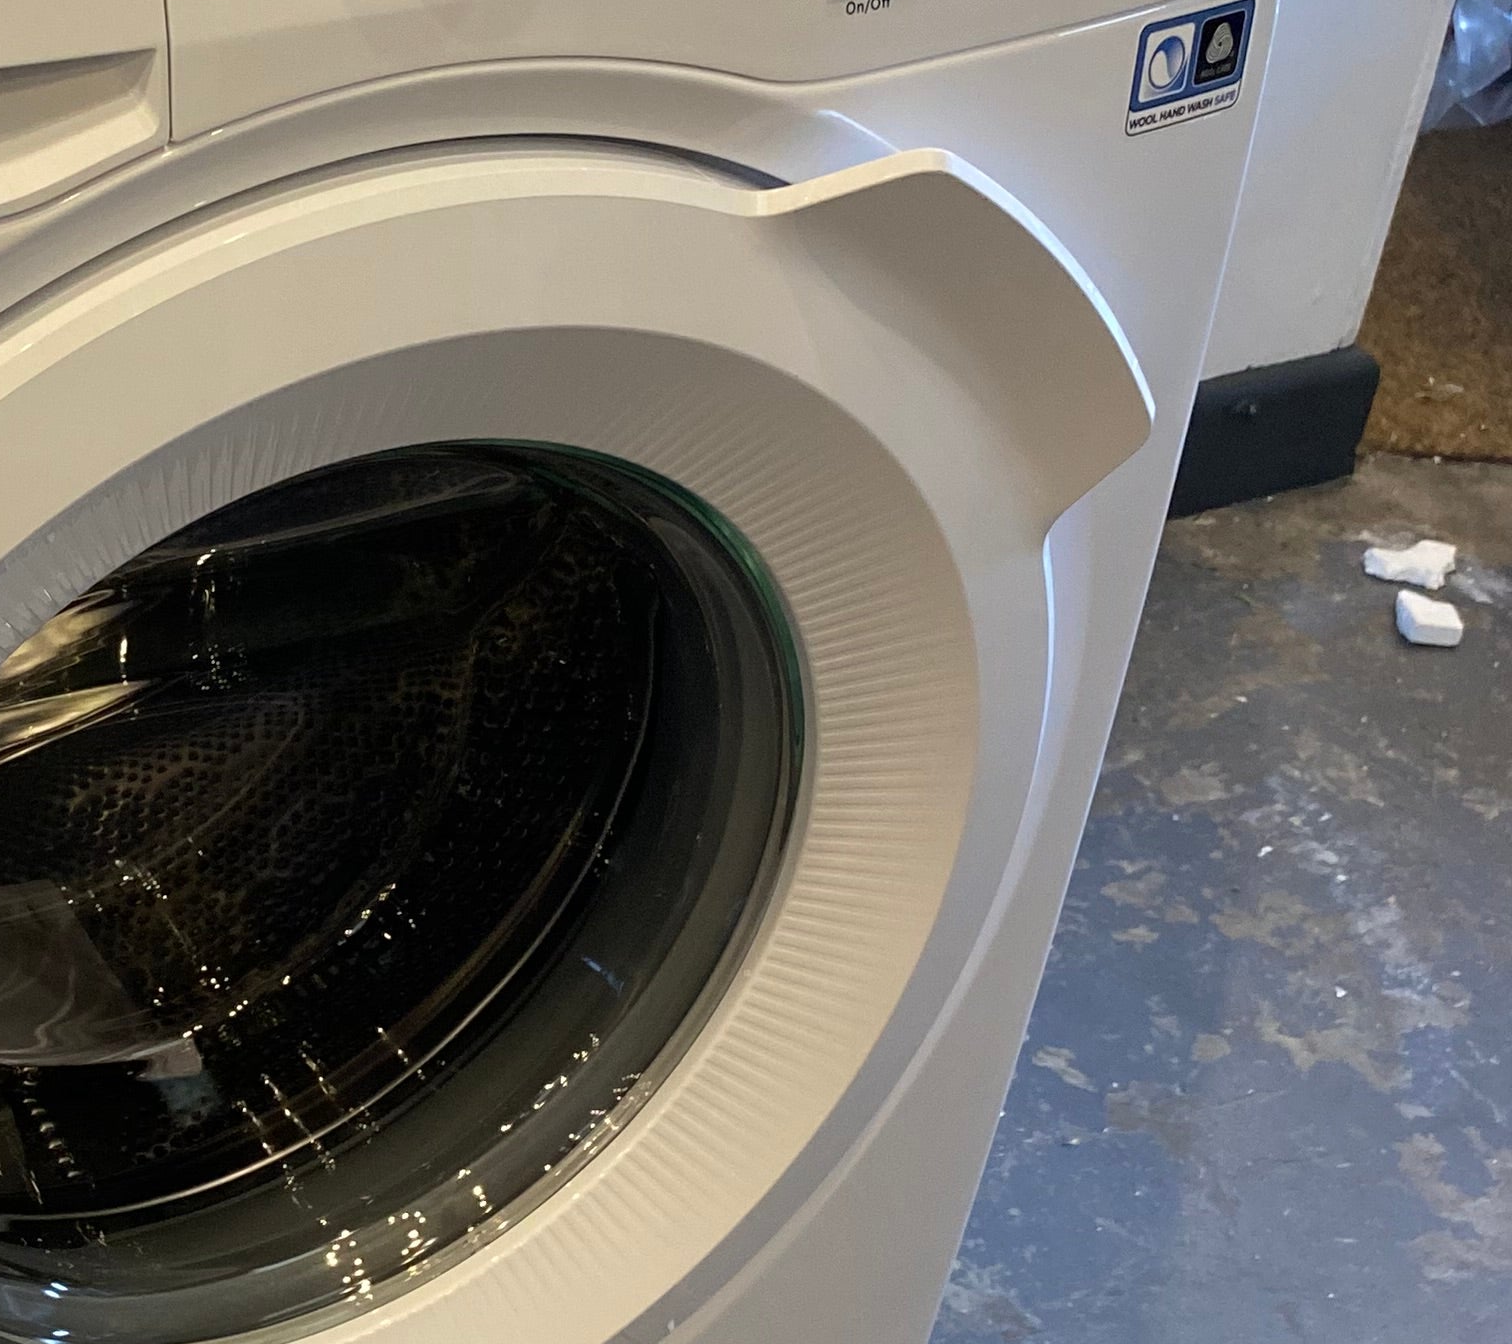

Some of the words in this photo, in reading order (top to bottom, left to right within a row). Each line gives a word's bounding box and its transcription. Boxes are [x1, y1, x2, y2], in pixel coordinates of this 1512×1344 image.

[1129, 115, 1158, 130] WOOL
[1160, 106, 1185, 121] HAND
[1188, 97, 1213, 113] WASH
[1215, 89, 1237, 106] SAFE
